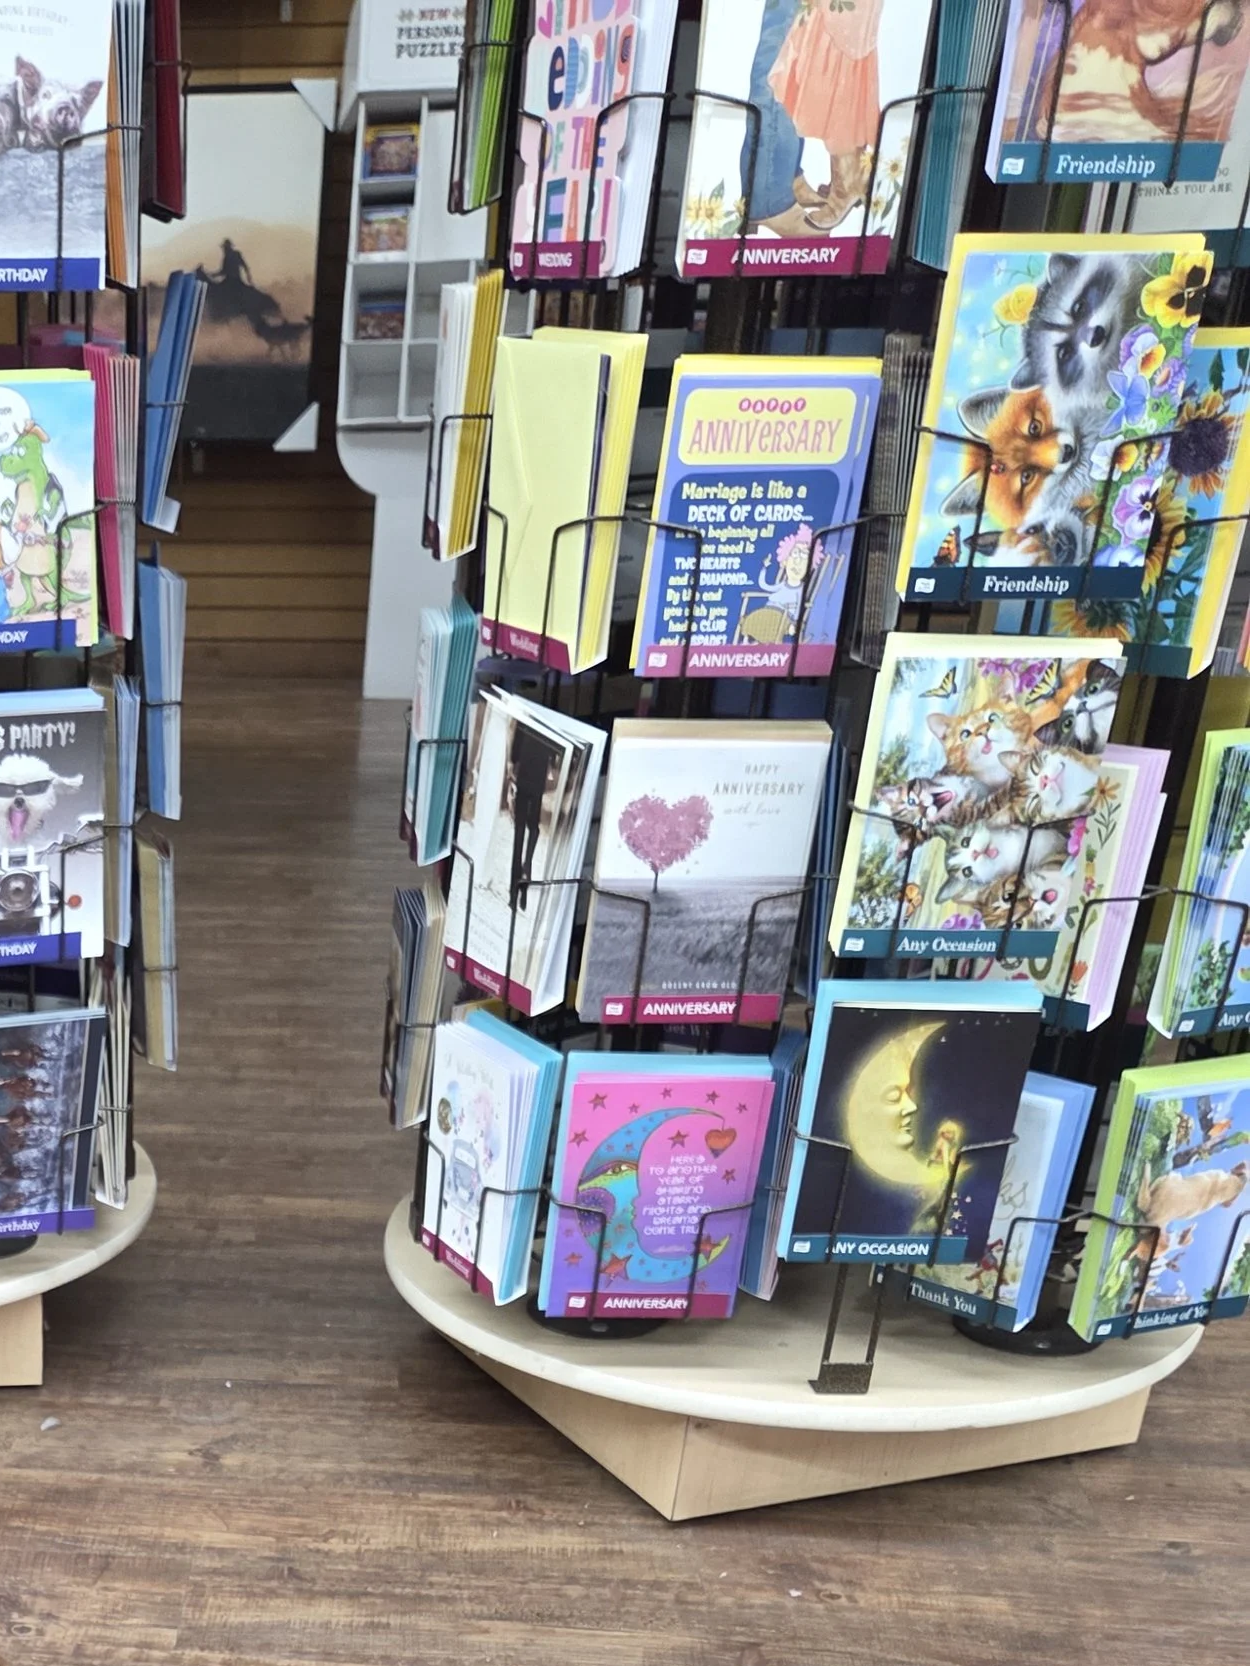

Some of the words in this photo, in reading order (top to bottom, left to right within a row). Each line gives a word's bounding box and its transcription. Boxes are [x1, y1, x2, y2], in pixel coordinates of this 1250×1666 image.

[396, 25, 463, 39] PERSONA
[1055, 153, 1156, 178] Friendship
[1184, 184, 1206, 194] YOU
[1209, 182, 1232, 193] ARE
[731, 247, 840, 265] ANNIVERSARY
[682, 482, 748, 504] Marriage
[751, 481, 764, 499] is
[767, 480, 793, 499] like
[796, 485, 807, 499] a
[687, 504, 728, 522] DECK
[730, 504, 752, 522] OF
[760, 524, 775, 538] all
[699, 557, 741, 570] HEARTS
[983, 573, 1070, 596] Friendship
[688, 652, 790, 668] ANNIVERSARY
[9, 721, 77, 751] PARTY!
[744, 763, 780, 775] HAPPY
[712, 782, 805, 796] ANNIVERSARY
[897, 937, 928, 954] Any
[932, 936, 997, 952] Occasion
[642, 1001, 737, 1016] ANNIVERSARY
[1218, 1012, 1243, 1028] Any
[825, 1242, 858, 1255] ANY
[860, 1242, 929, 1255] OCCASION
[603, 1296, 689, 1310] ANNIVERSARY
[911, 1281, 951, 1307] Thank
[953, 1296, 977, 1316] You
[1127, 1311, 1179, 1329] hinking
[1195, 1304, 1209, 1319] Yo
